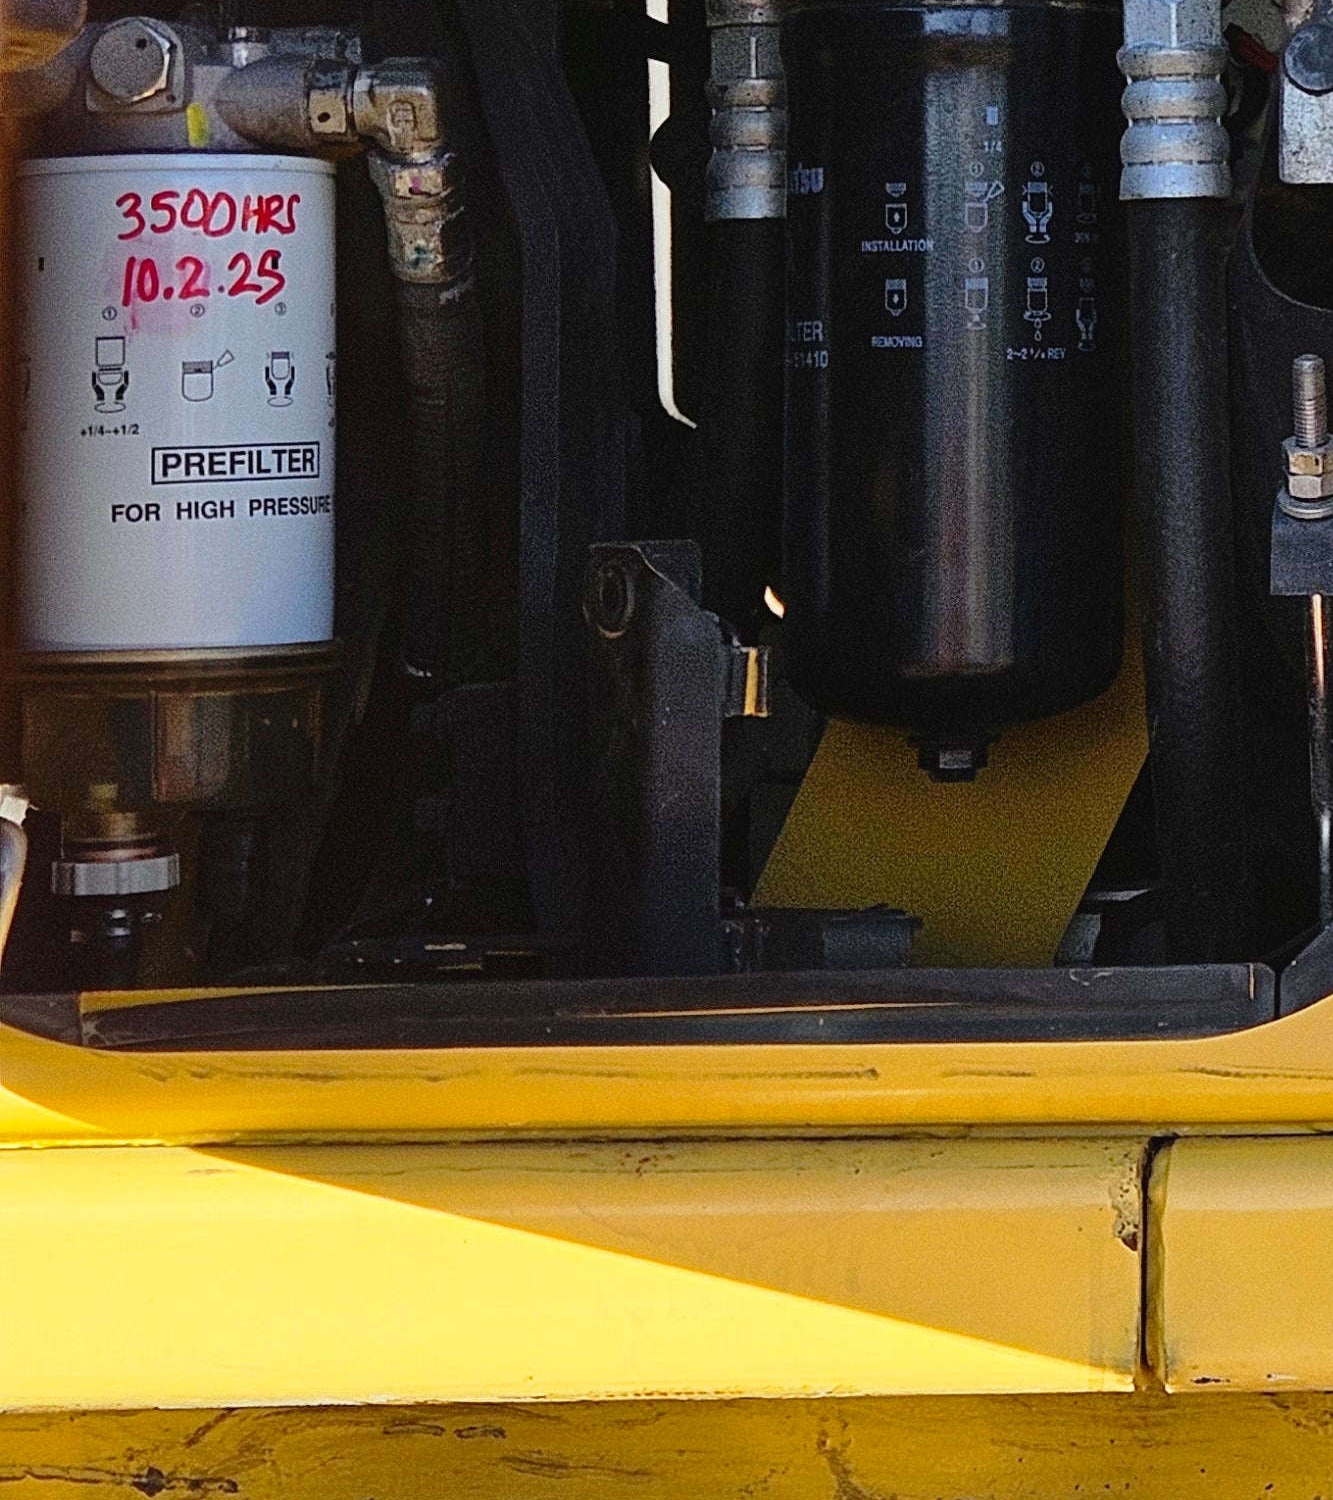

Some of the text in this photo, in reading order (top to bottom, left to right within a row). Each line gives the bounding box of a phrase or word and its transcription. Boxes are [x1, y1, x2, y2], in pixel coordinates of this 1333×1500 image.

[860, 239, 935, 253] INSTALLATION
[871, 335, 923, 349] REMOVING
[161, 447, 316, 479] PREFILTER
[111, 503, 161, 524] FOR
[176, 500, 235, 521] HIGH
